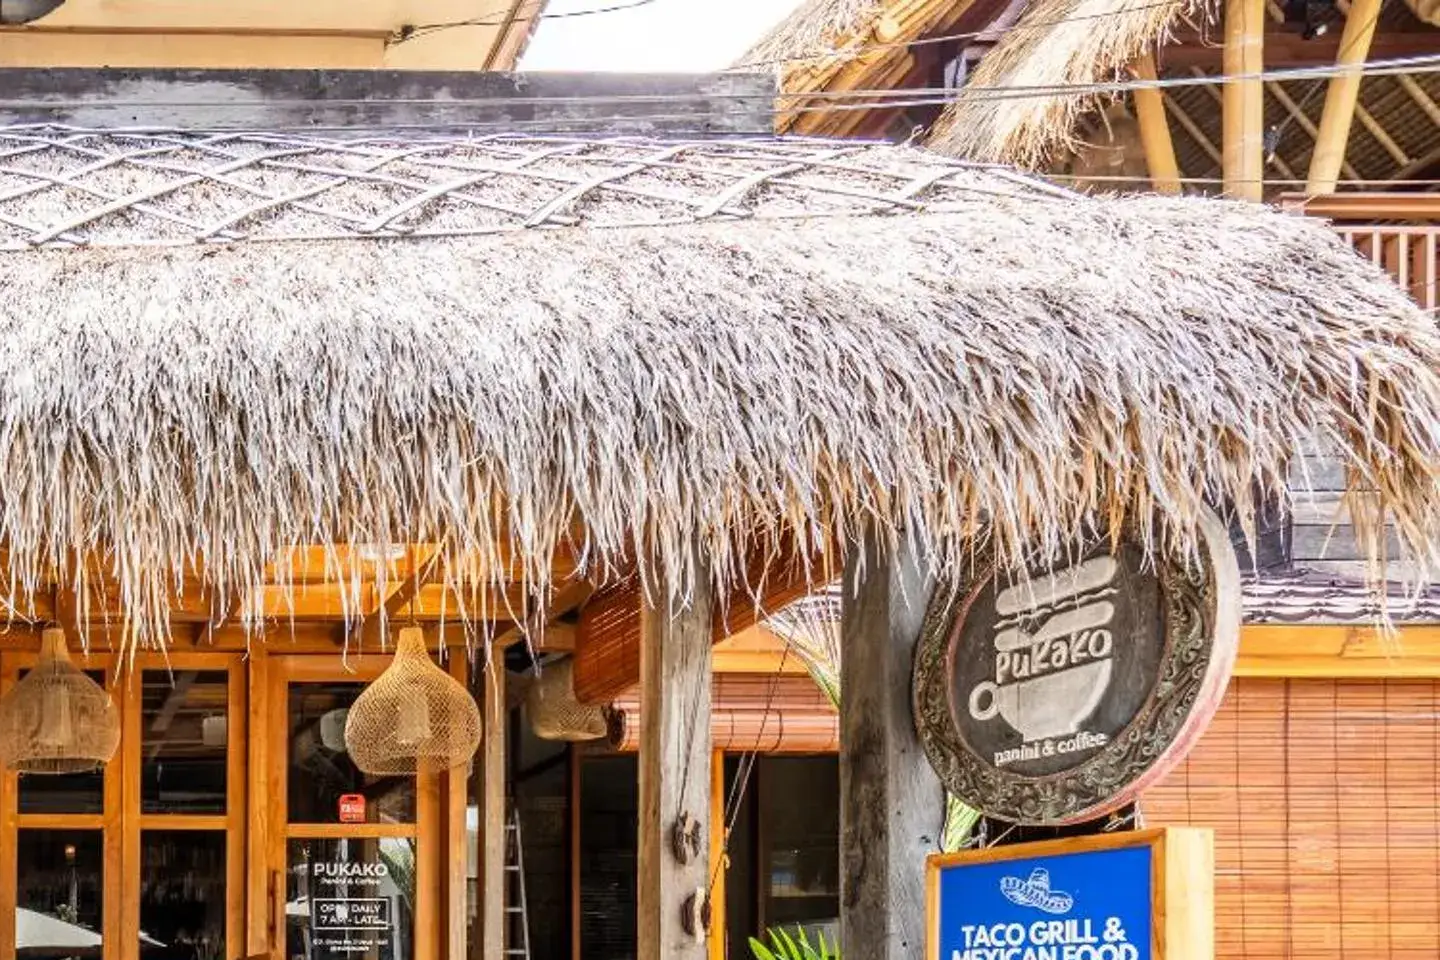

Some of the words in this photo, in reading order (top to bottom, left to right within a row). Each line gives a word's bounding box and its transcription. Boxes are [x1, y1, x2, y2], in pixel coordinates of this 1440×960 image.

[993, 741, 1039, 767] panini
[1042, 739, 1055, 756] &
[1057, 730, 1109, 752] coffee
[314, 862, 389, 877] PUKAKO
[351, 904, 381, 914] DAILY
[961, 922, 1026, 949] TACO
[1029, 918, 1099, 946] GRILL
[1102, 916, 1128, 942] &
